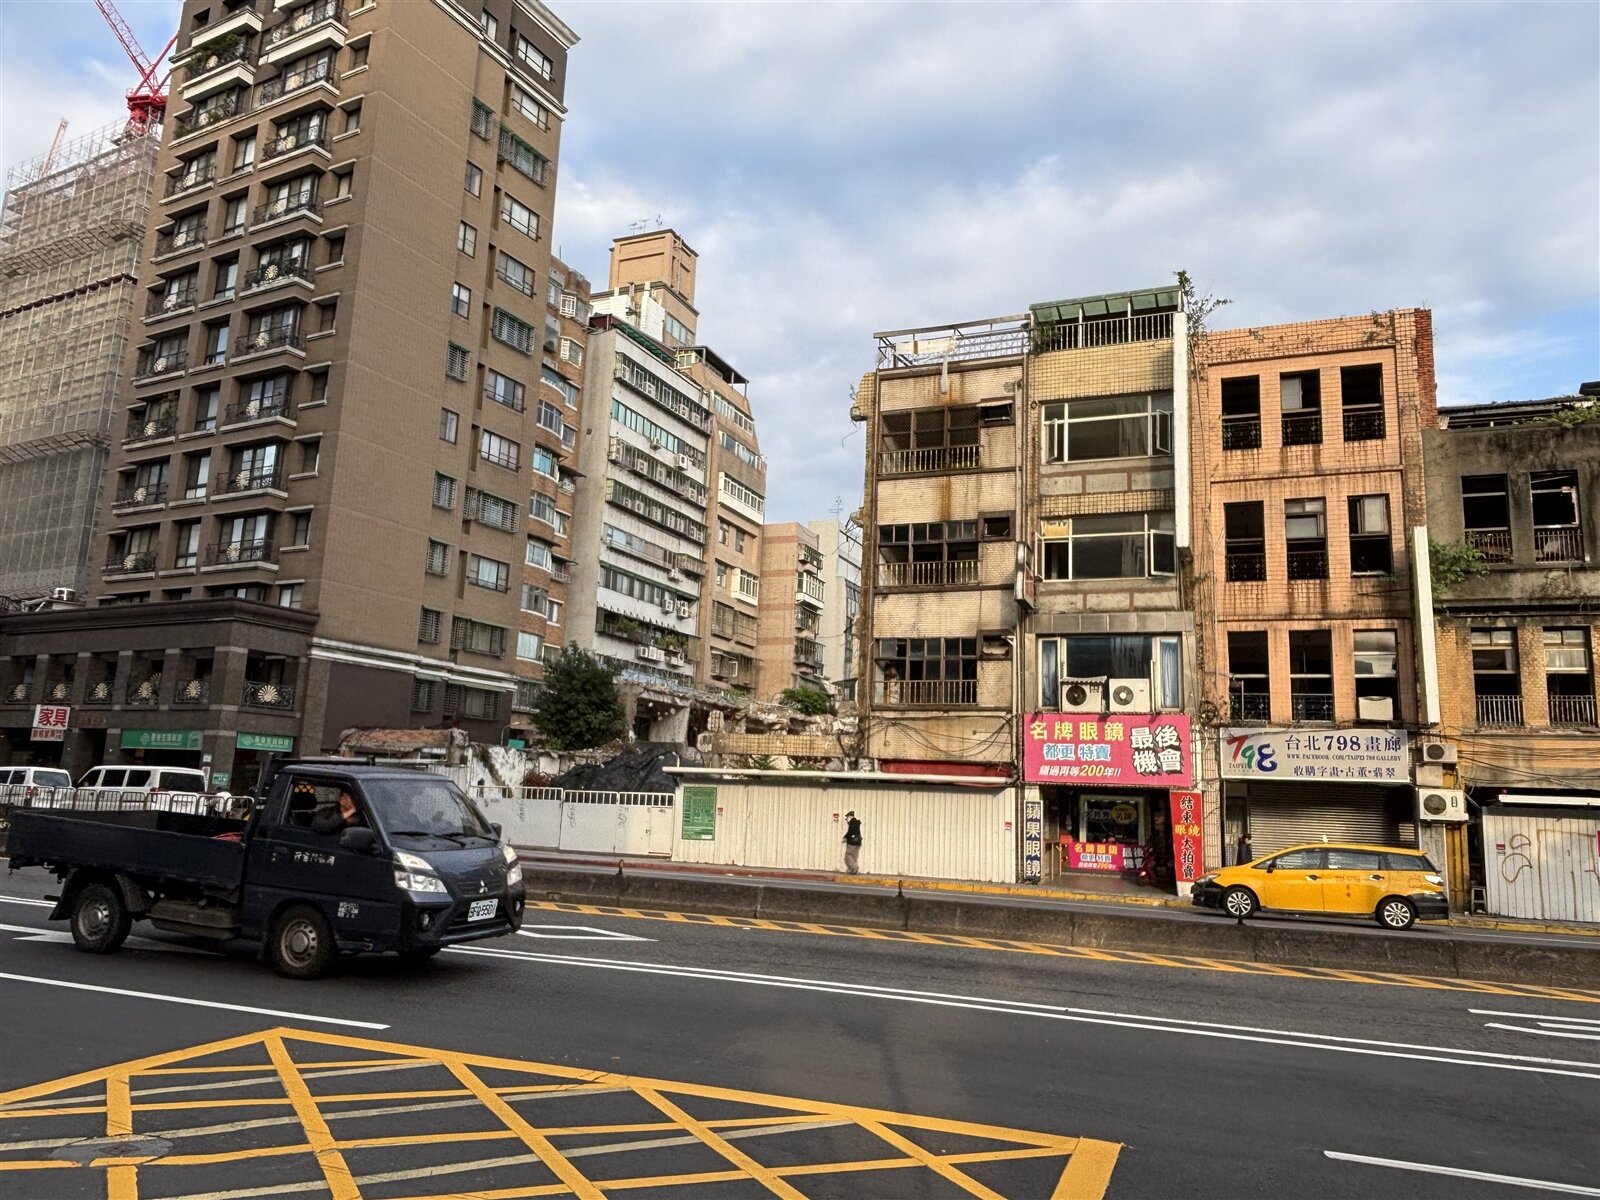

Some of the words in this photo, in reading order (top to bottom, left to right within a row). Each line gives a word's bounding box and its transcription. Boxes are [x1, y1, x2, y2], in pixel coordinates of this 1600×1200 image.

[39, 707, 68, 728] 家具
[1030, 721, 1124, 741] 名牌眼鏡
[1130, 724, 1180, 749] 最後
[1043, 743, 1075, 760] 都更
[1078, 744, 1111, 761] 特賣
[1132, 749, 1182, 774] 機會
[1180, 796, 1196, 824] 結束
[1026, 803, 1041, 877] 蘋果眼鏡
[1175, 824, 1201, 836] 眼鏡
[1181, 836, 1196, 879] 大拍賣
